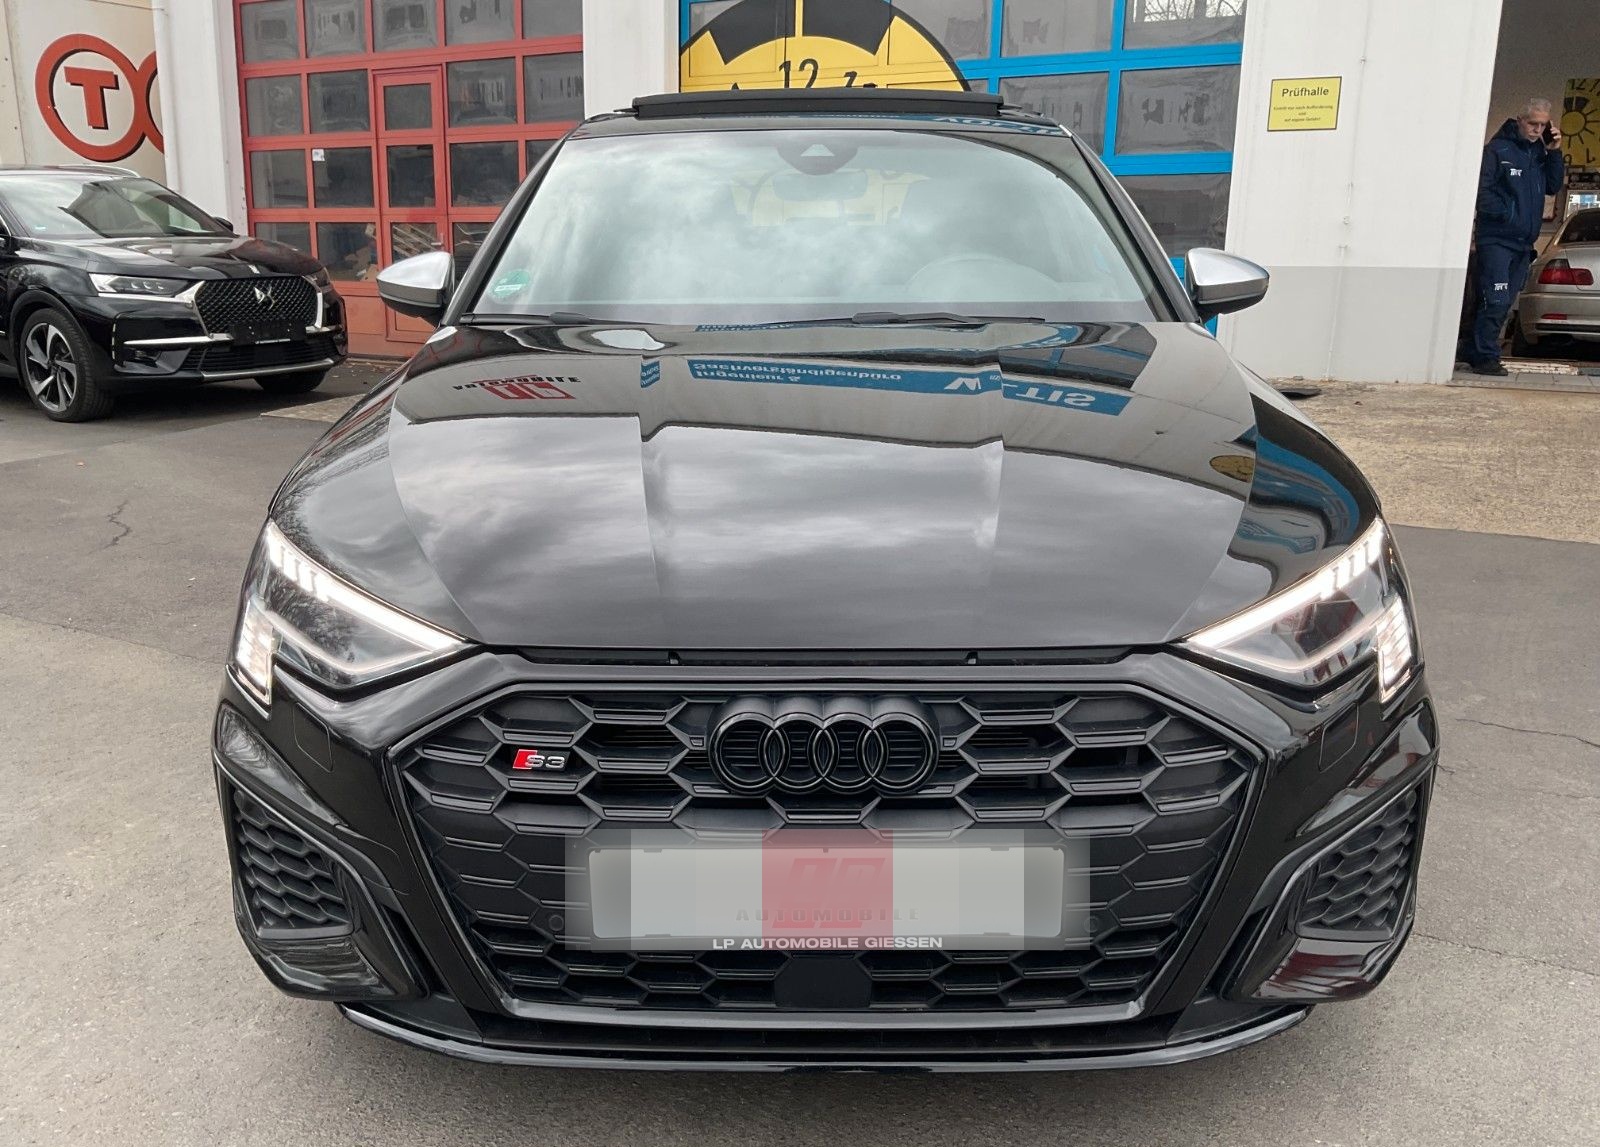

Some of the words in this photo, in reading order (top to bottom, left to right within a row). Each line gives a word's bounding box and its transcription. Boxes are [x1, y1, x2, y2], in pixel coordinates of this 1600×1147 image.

[1281, 86, 1330, 97] Prüfhalle
[524, 754, 566, 769] S3
[712, 938, 735, 950] LP
[741, 937, 859, 949] AUTOMOBILE
[864, 936, 943, 949] GIESSEN
